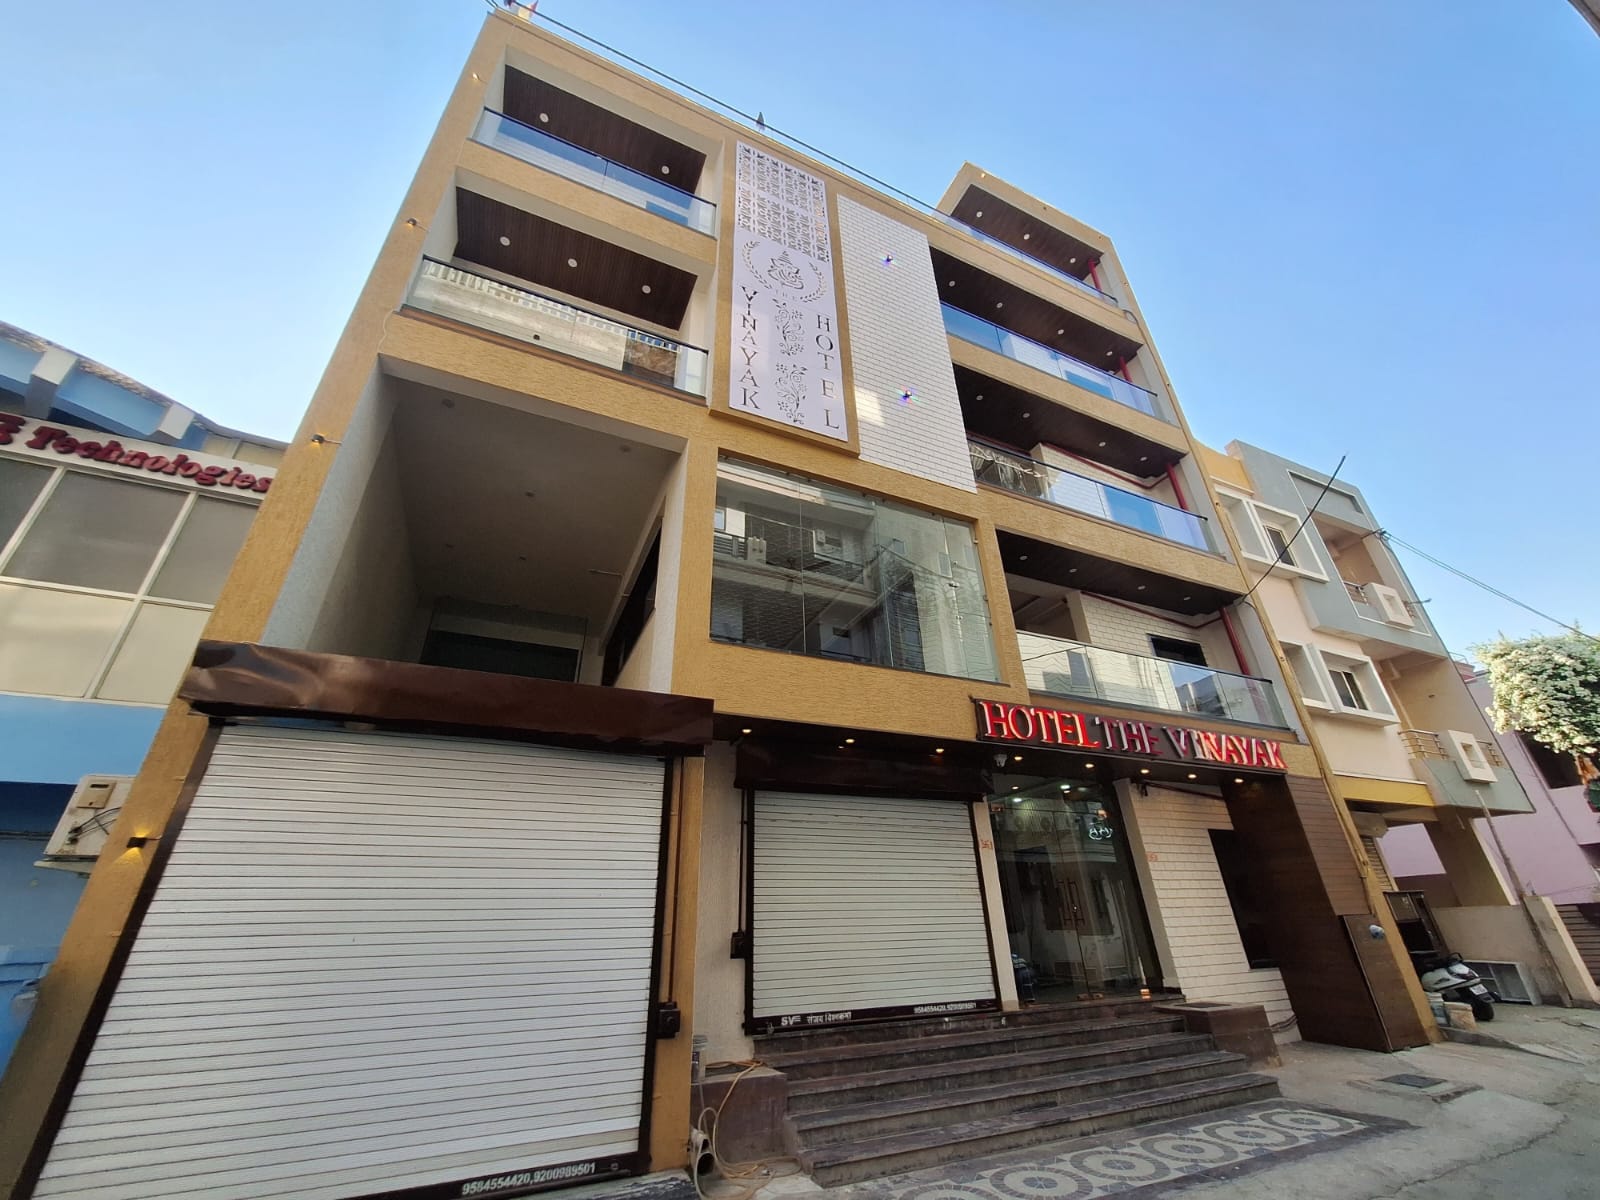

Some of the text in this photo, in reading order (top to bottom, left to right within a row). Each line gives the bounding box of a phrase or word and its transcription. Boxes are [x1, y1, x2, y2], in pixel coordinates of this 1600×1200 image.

[739, 286, 761, 409] VINAYAK
[815, 314, 840, 430] HOTEL
[25, 426, 273, 493] Technologies
[979, 701, 1288, 769] HOTEL THE VINAYAK
